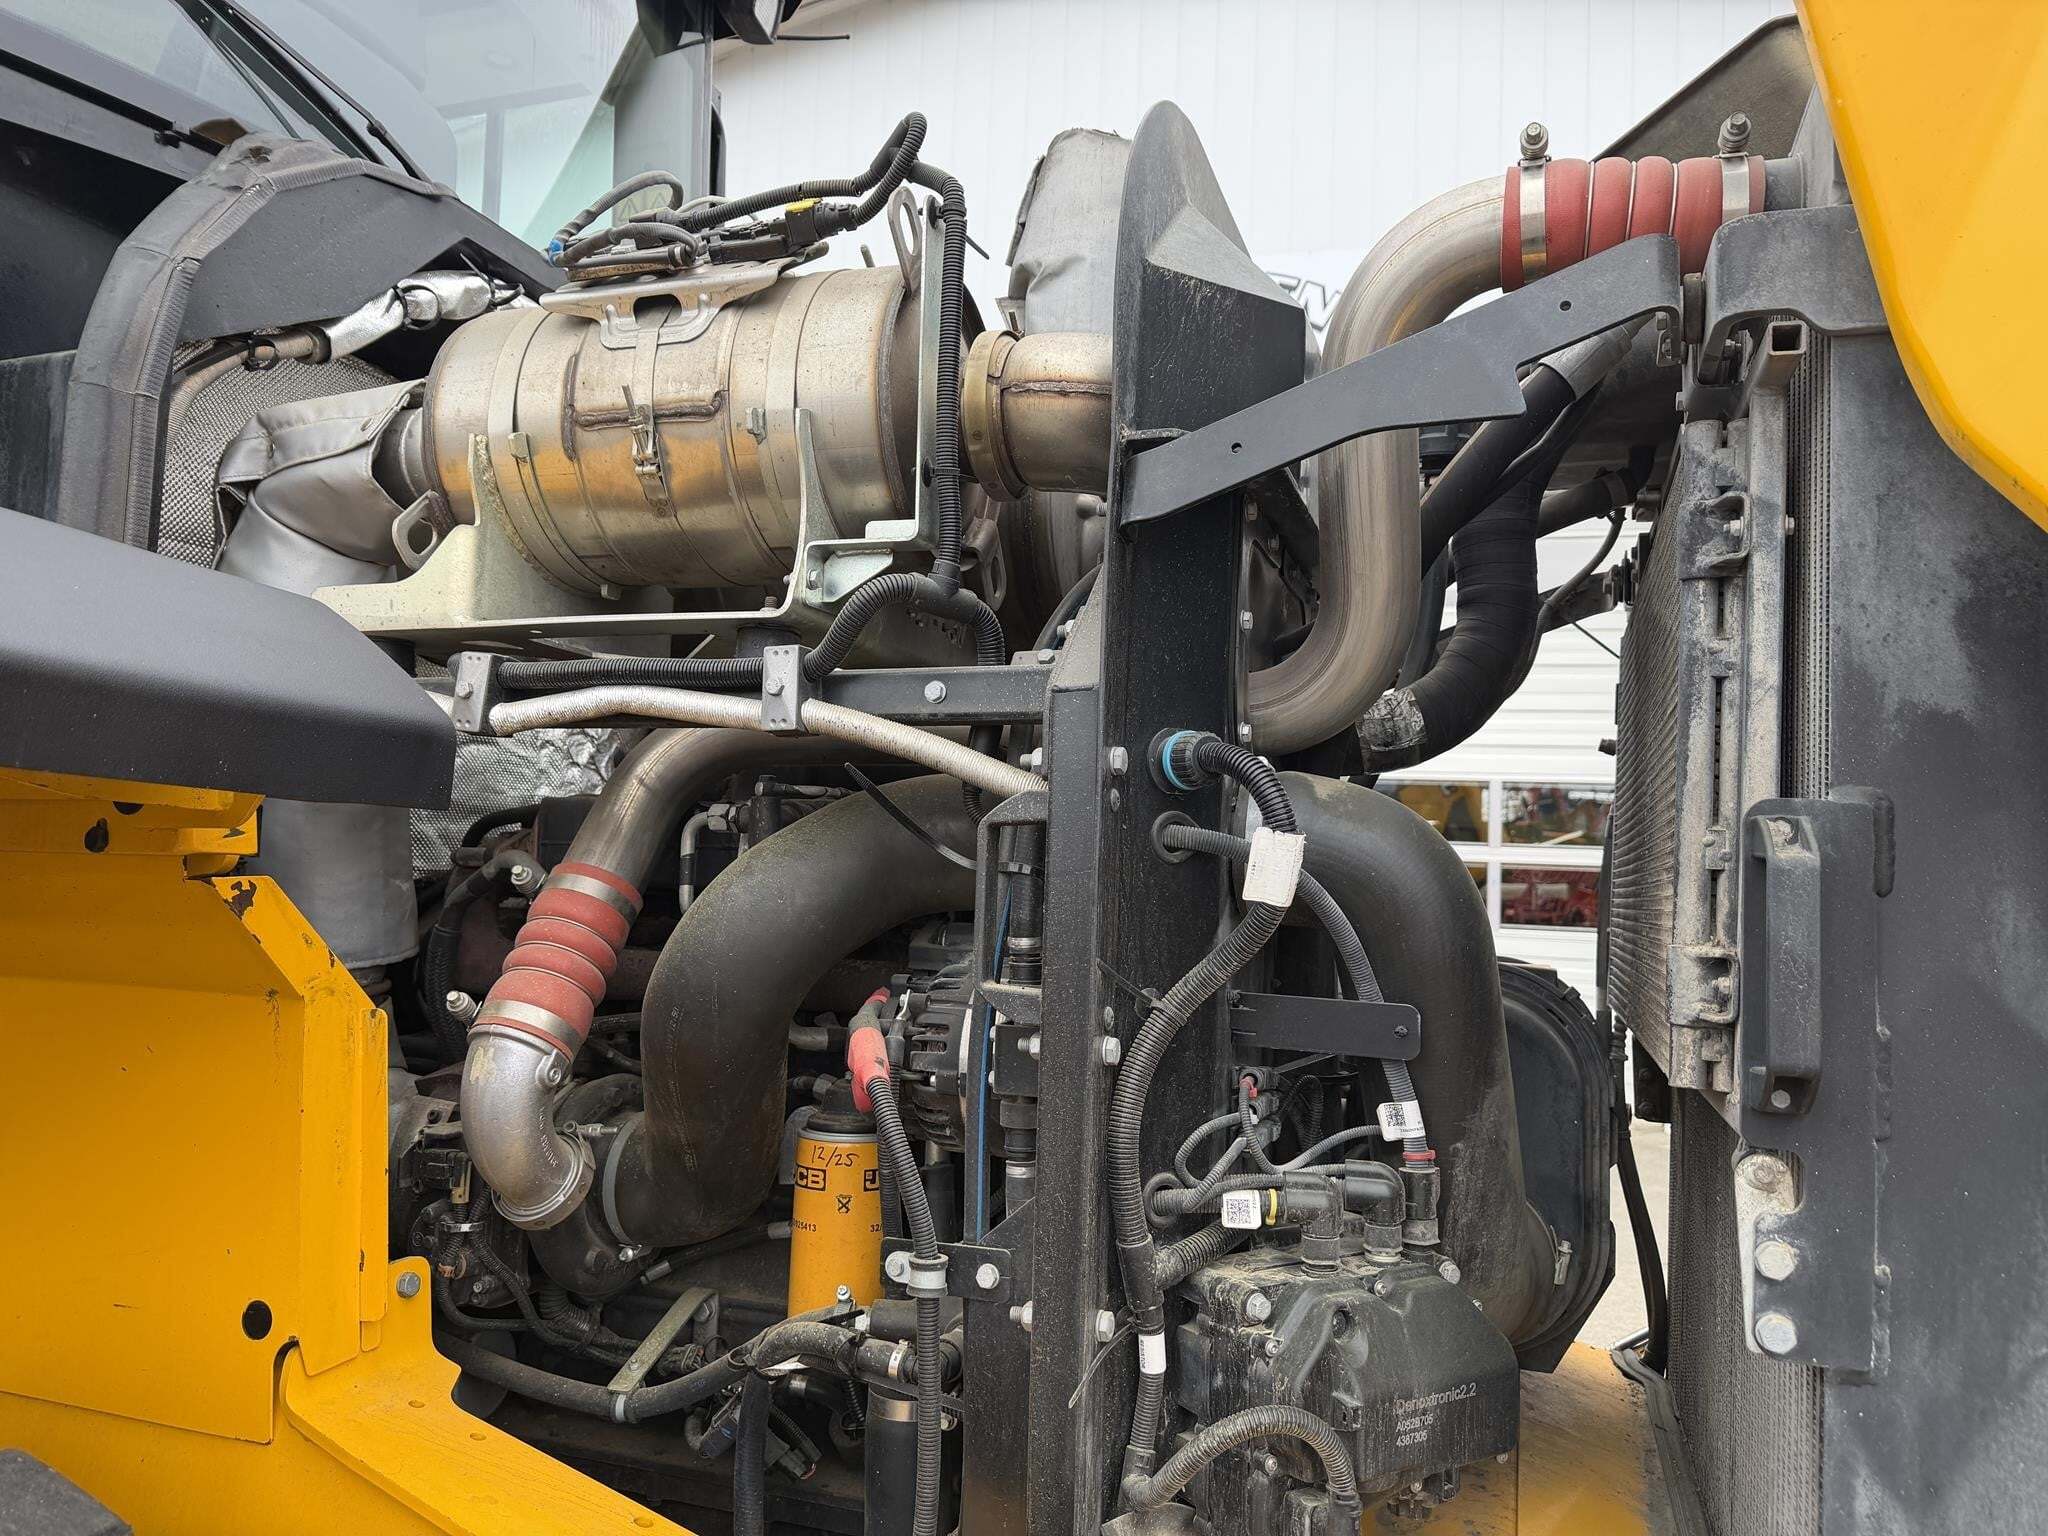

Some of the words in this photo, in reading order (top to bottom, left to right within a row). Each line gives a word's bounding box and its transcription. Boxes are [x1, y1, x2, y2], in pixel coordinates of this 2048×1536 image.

[811, 1145, 860, 1168] 12/25
[796, 1166, 825, 1189] CB
[1396, 1430, 1428, 1448] 4387305
